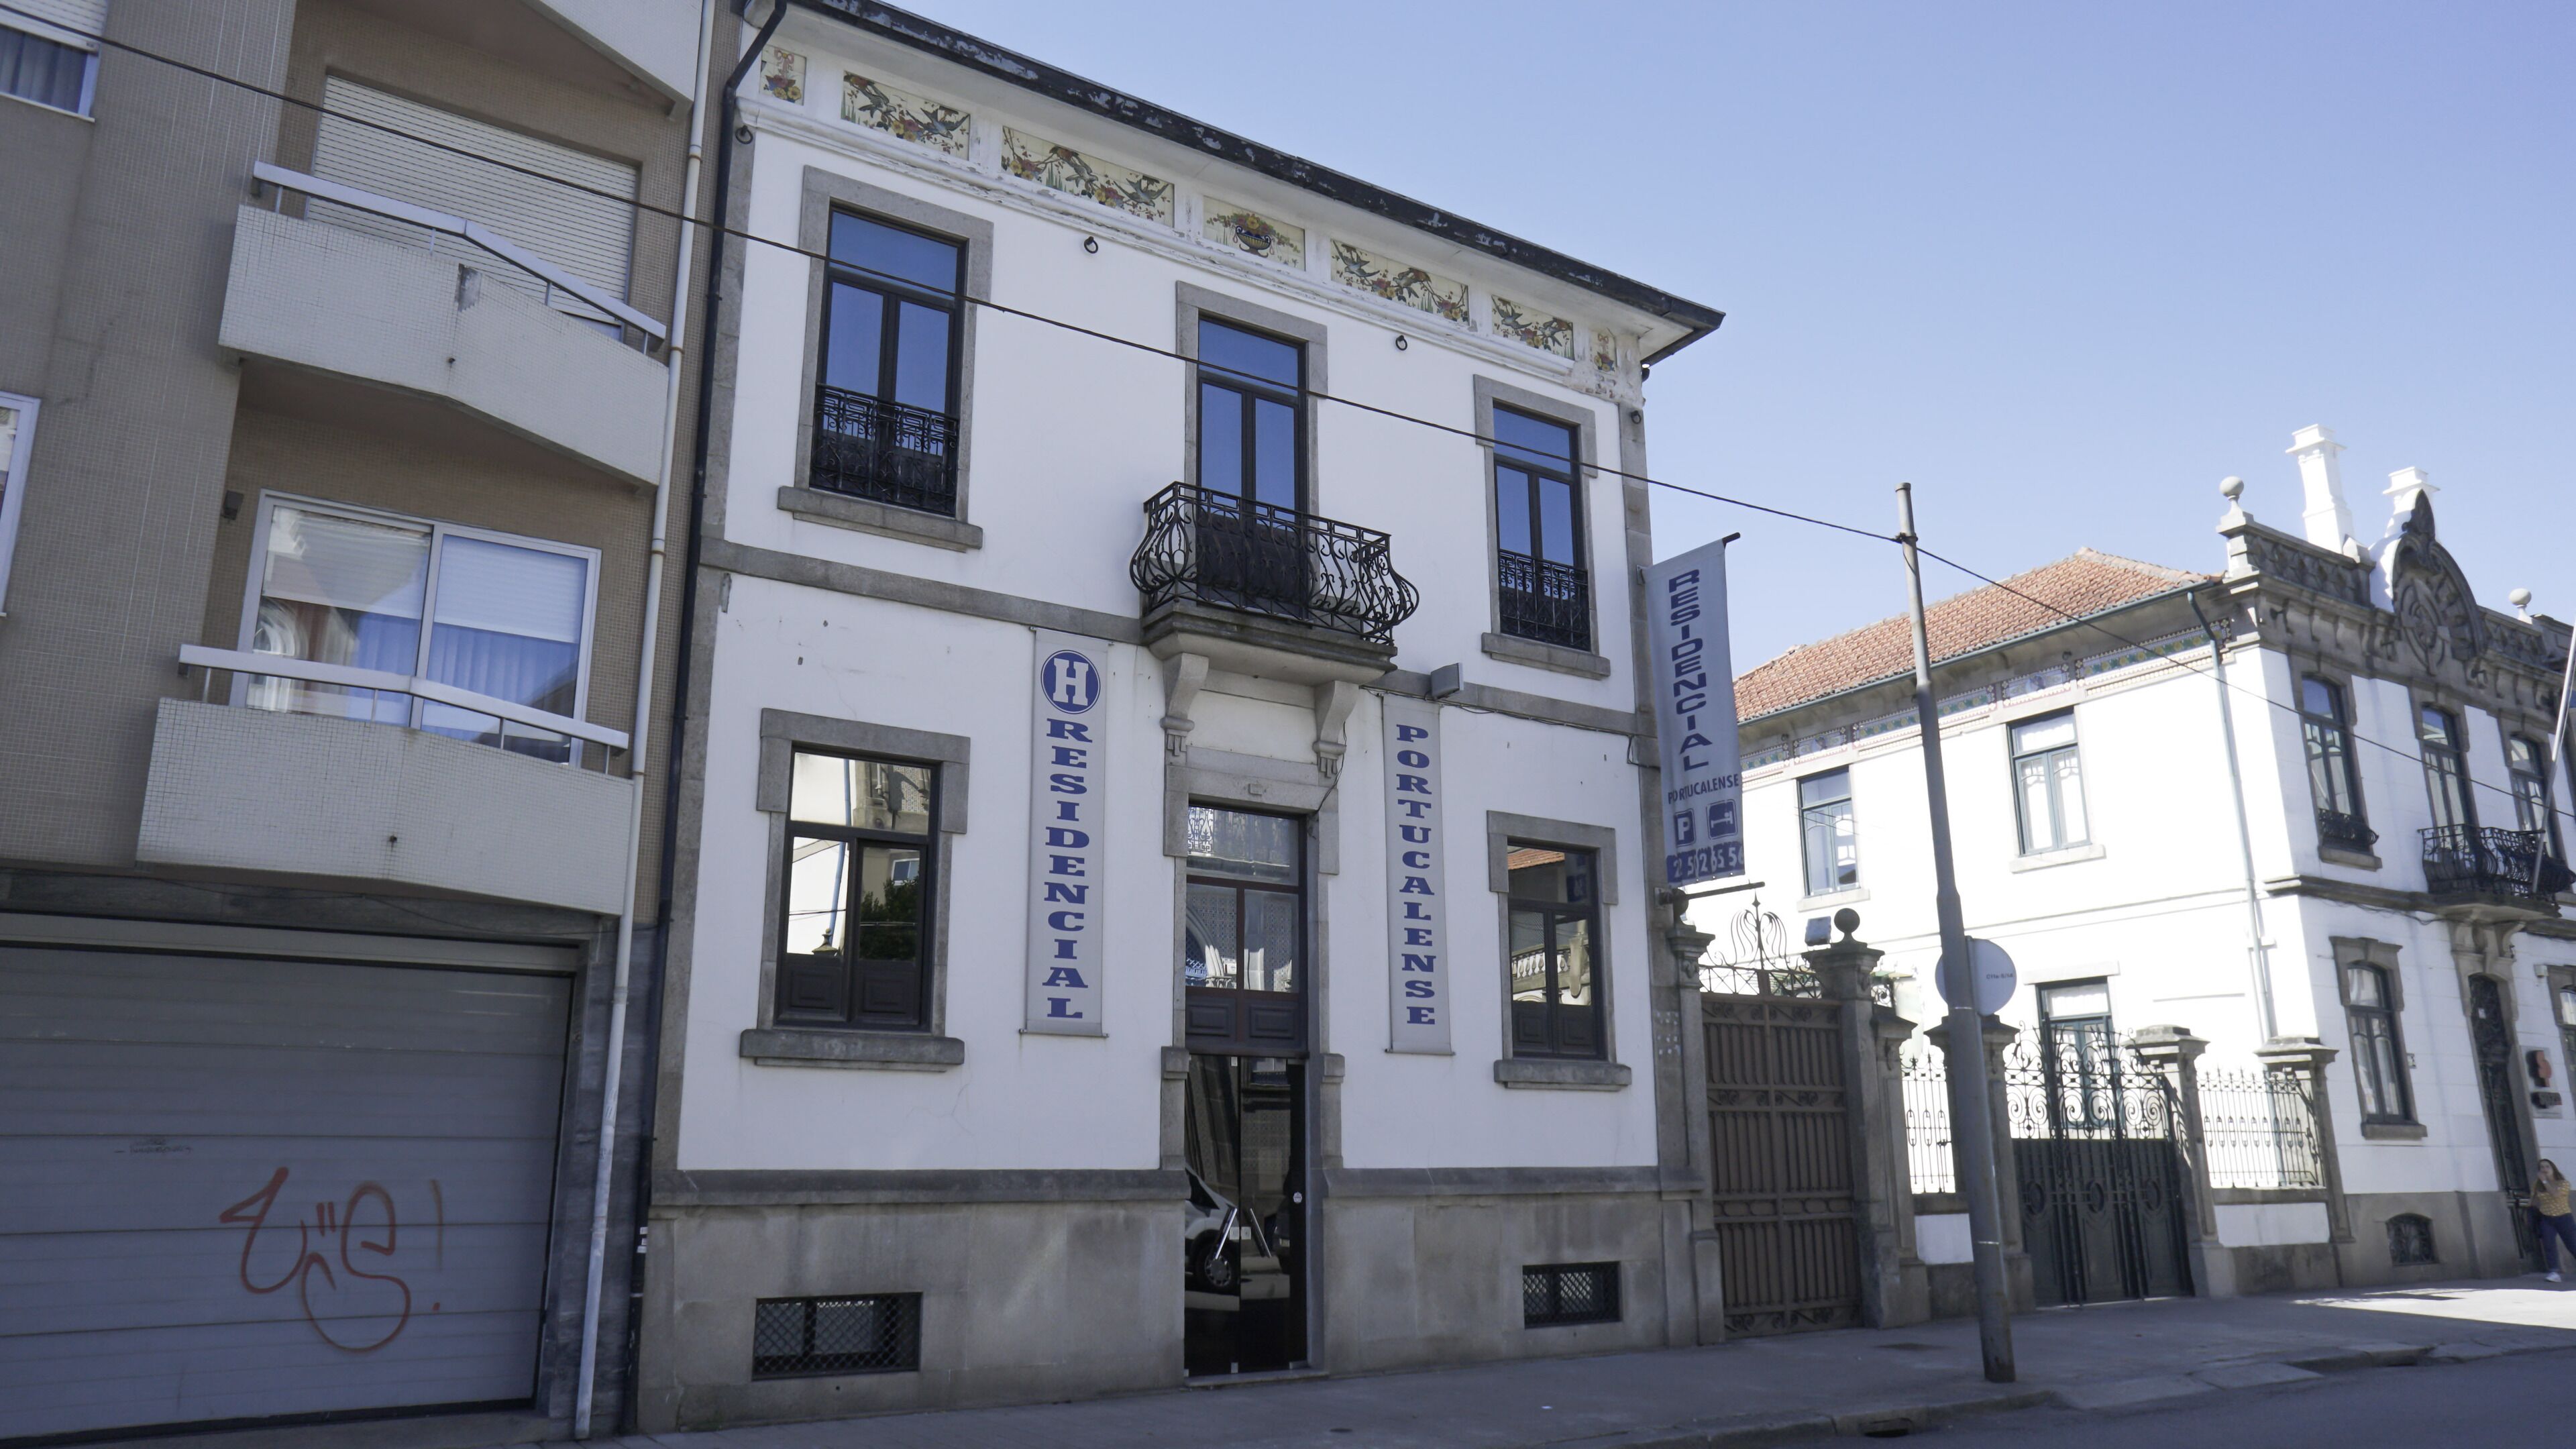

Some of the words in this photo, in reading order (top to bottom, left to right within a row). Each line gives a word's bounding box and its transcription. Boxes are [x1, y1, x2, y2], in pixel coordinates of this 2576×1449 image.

[1053, 658, 1089, 706] H
[1668, 569, 1714, 772] RESIDENCIAL
[1042, 718, 1093, 1019] RESIDENCIAL
[1396, 724, 1436, 1026] PORTUCALENSE
[1678, 817, 1690, 841] P
